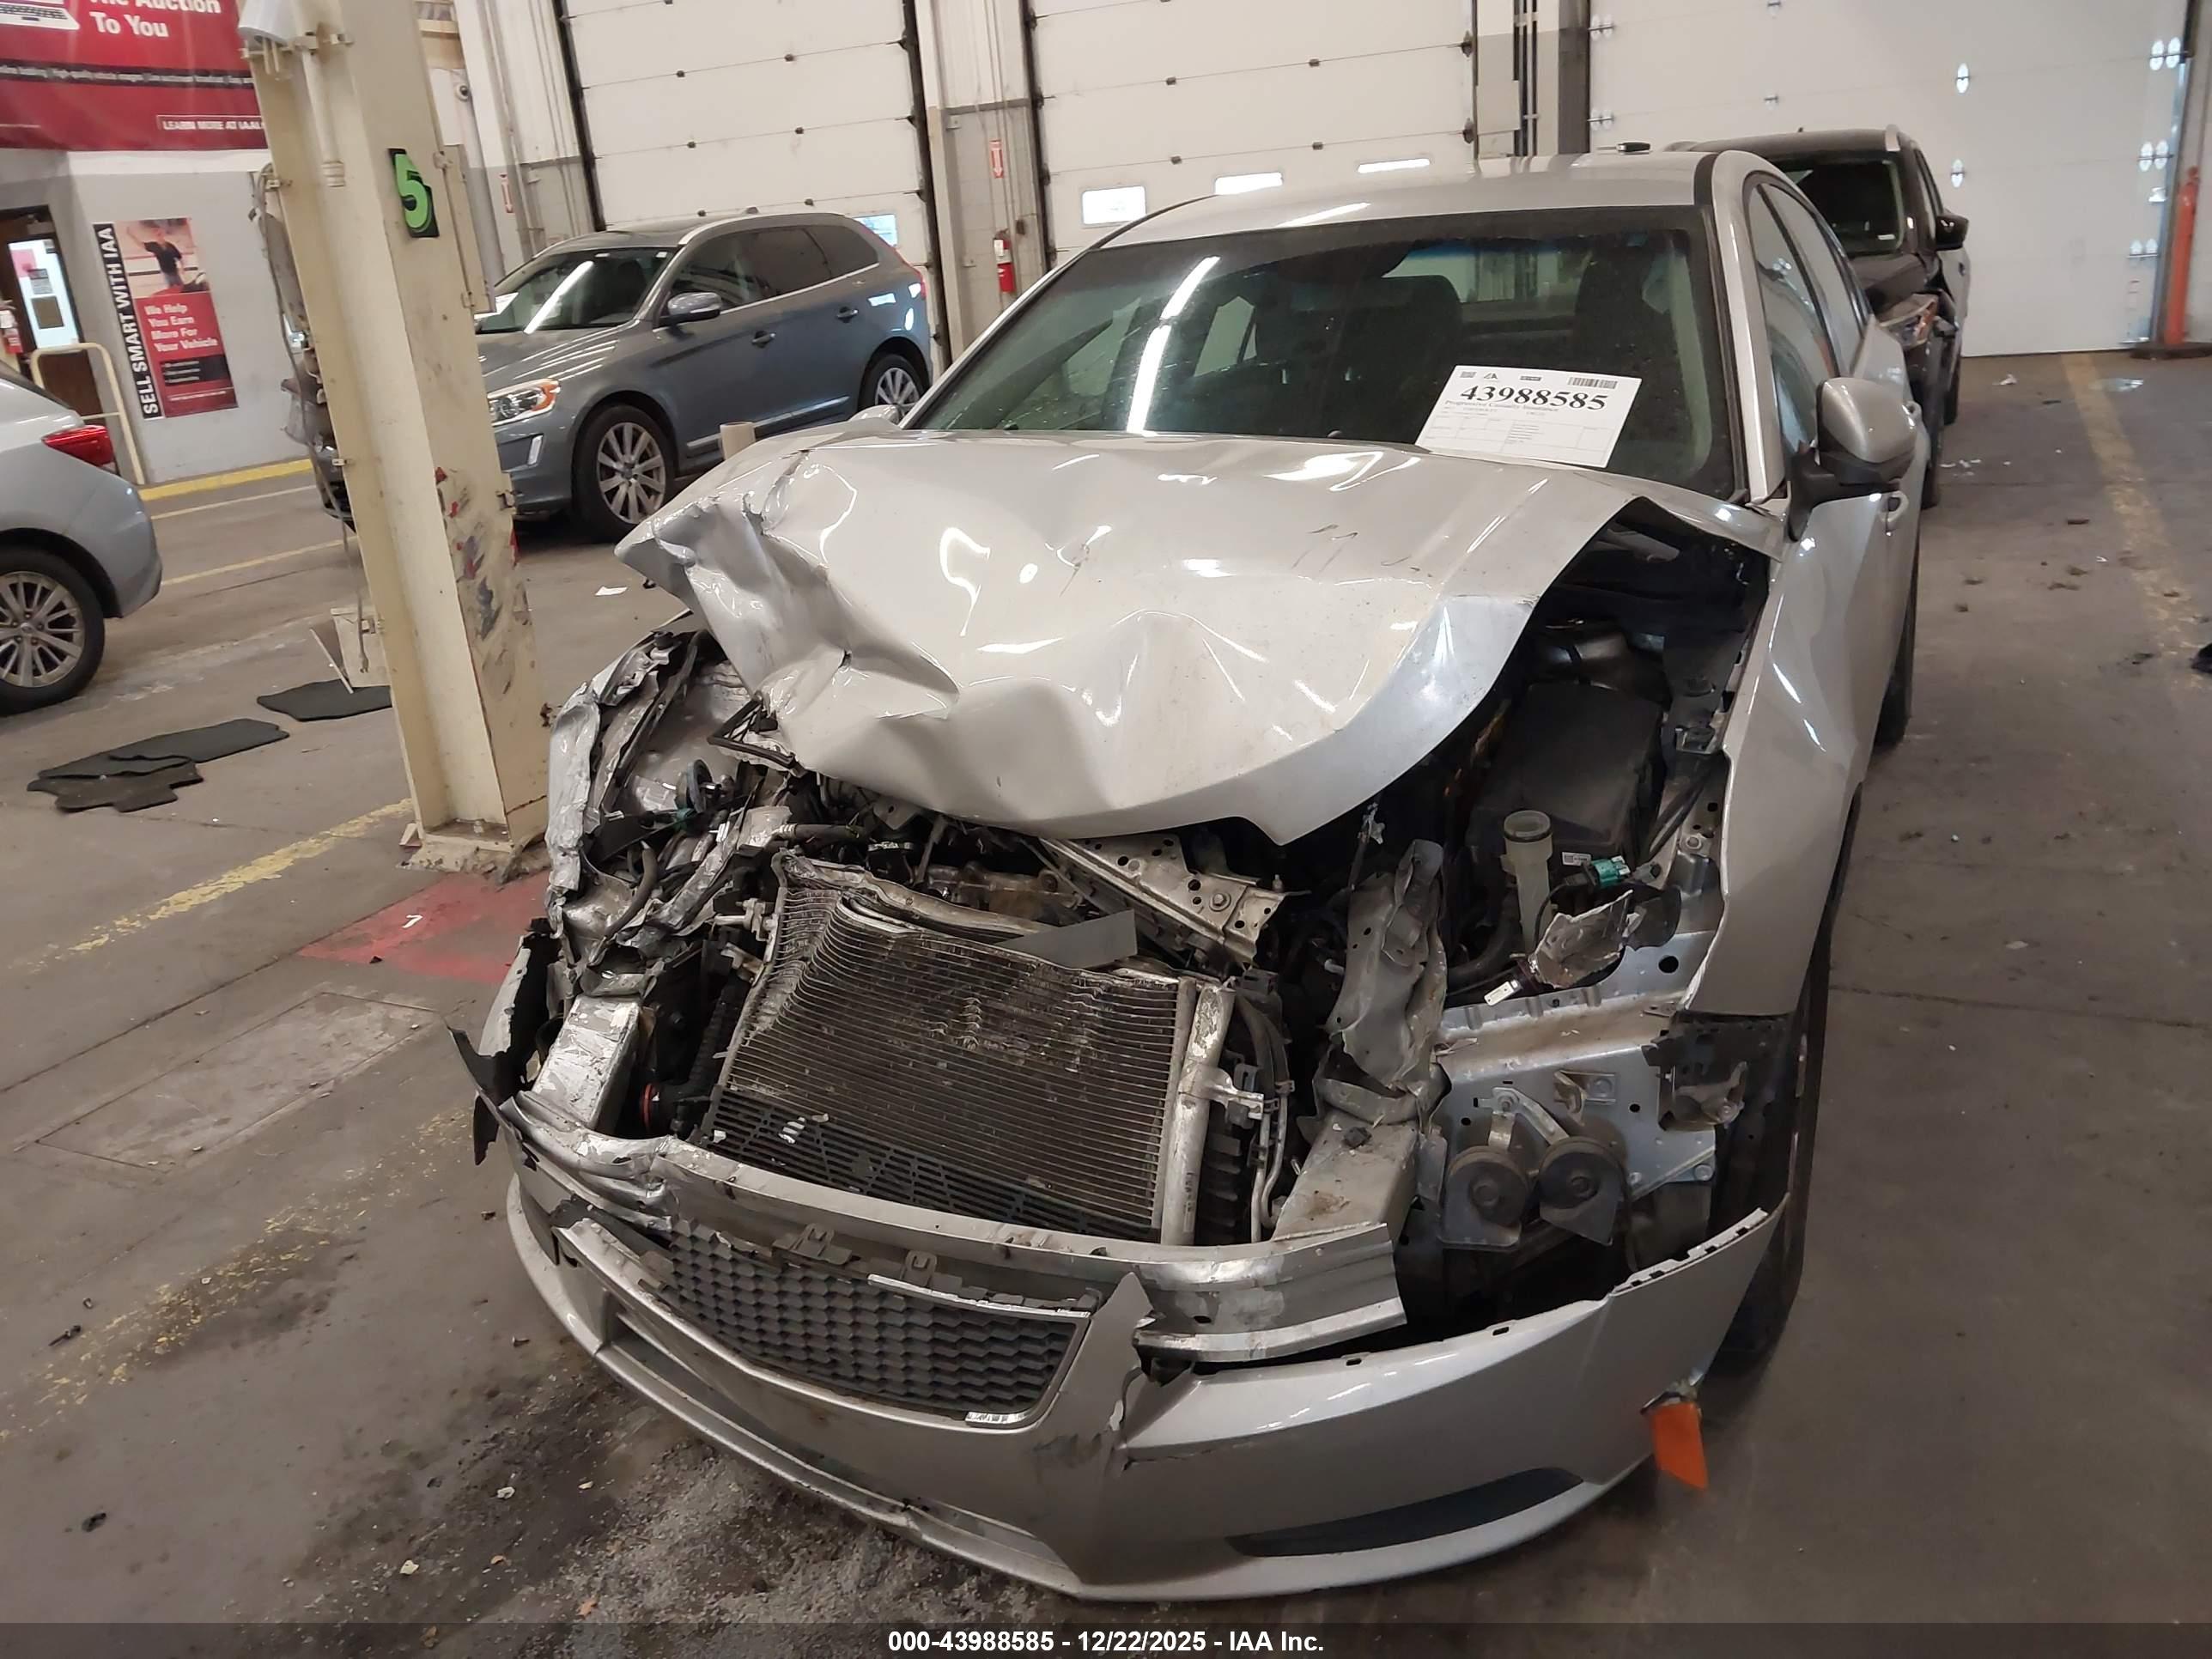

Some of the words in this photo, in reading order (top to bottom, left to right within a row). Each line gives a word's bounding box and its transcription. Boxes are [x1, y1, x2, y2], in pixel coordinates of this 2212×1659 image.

[89, 11, 121, 33] To
[124, 14, 169, 37] You
[395, 154, 428, 228] 5
[98, 227, 118, 258] IAA
[106, 263, 131, 309] WITH
[119, 313, 148, 373] SMART
[137, 375, 158, 414] SELL
[1461, 385, 1608, 410] 43988585
